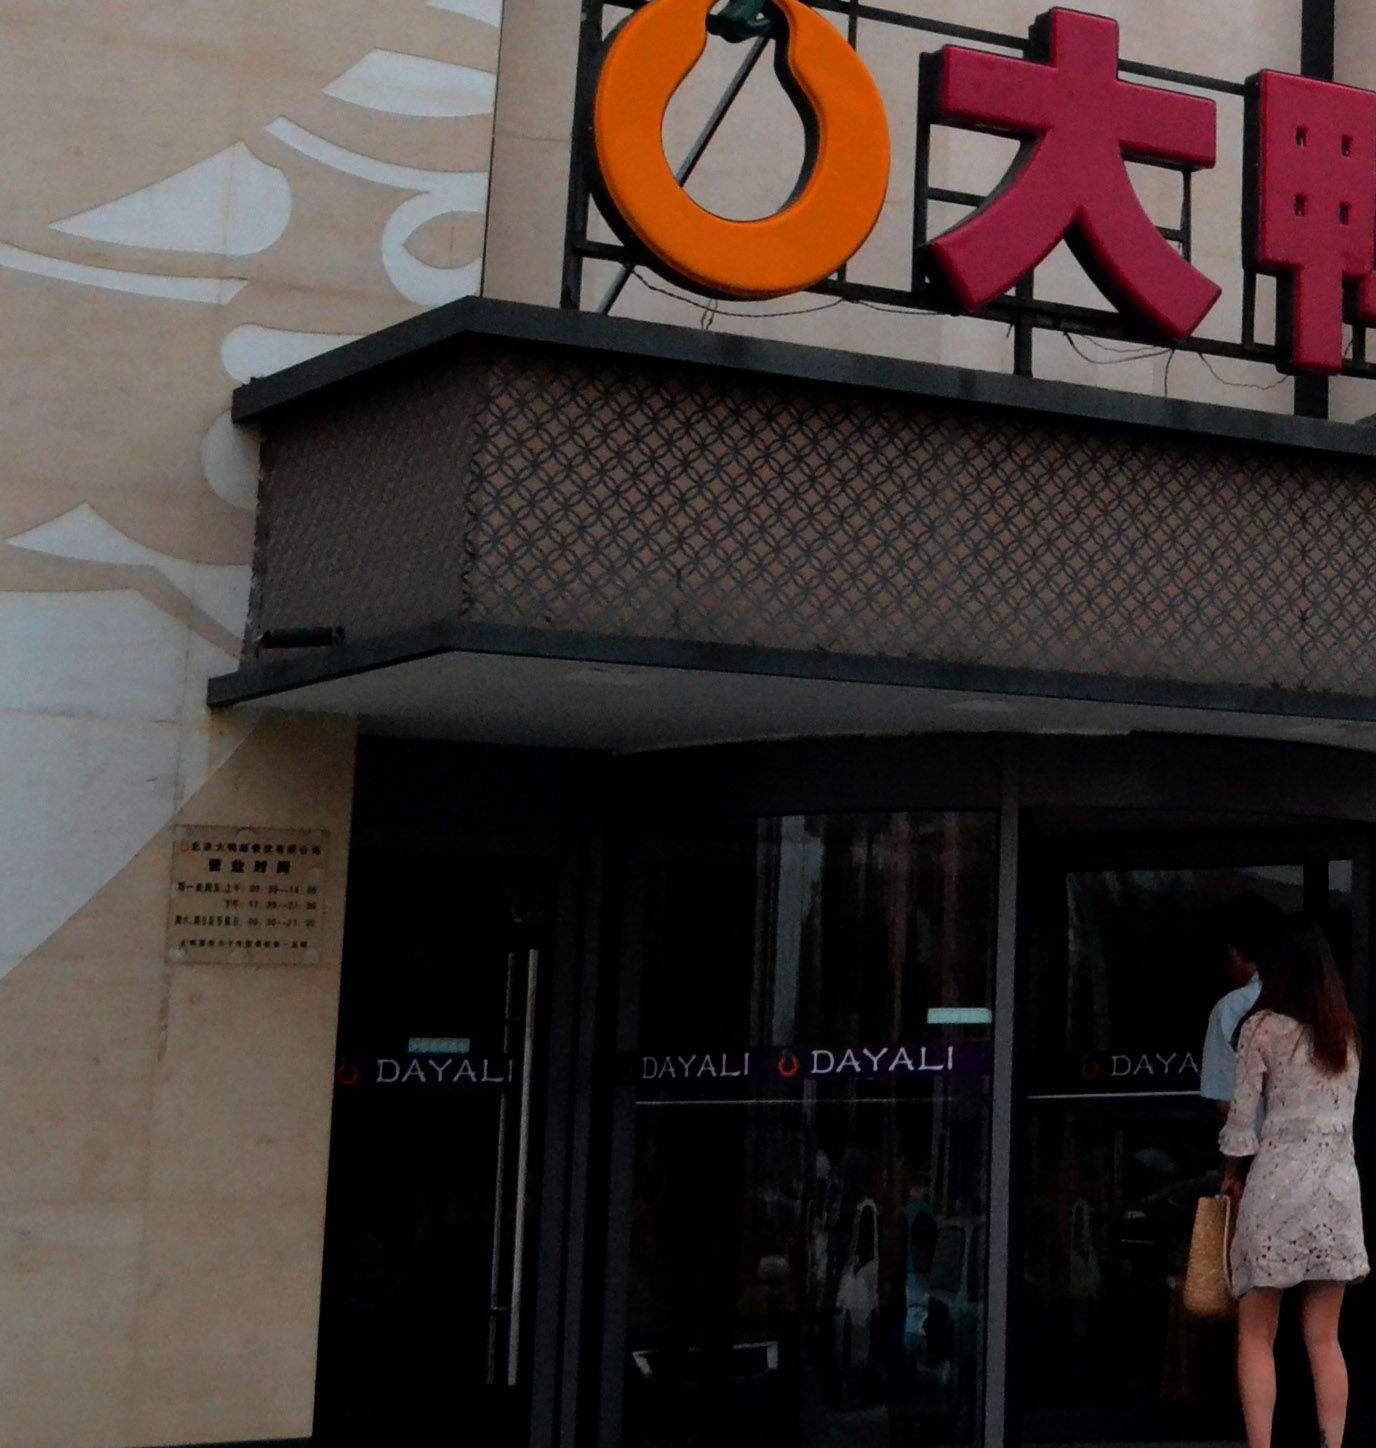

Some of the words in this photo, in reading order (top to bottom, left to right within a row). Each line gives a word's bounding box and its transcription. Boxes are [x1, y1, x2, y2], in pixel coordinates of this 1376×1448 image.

[376, 1059, 514, 1083] DAYALI
[641, 1052, 751, 1080] DAYALI
[810, 1045, 955, 1076] DAYALI
[1110, 1051, 1201, 1077] DAYA
